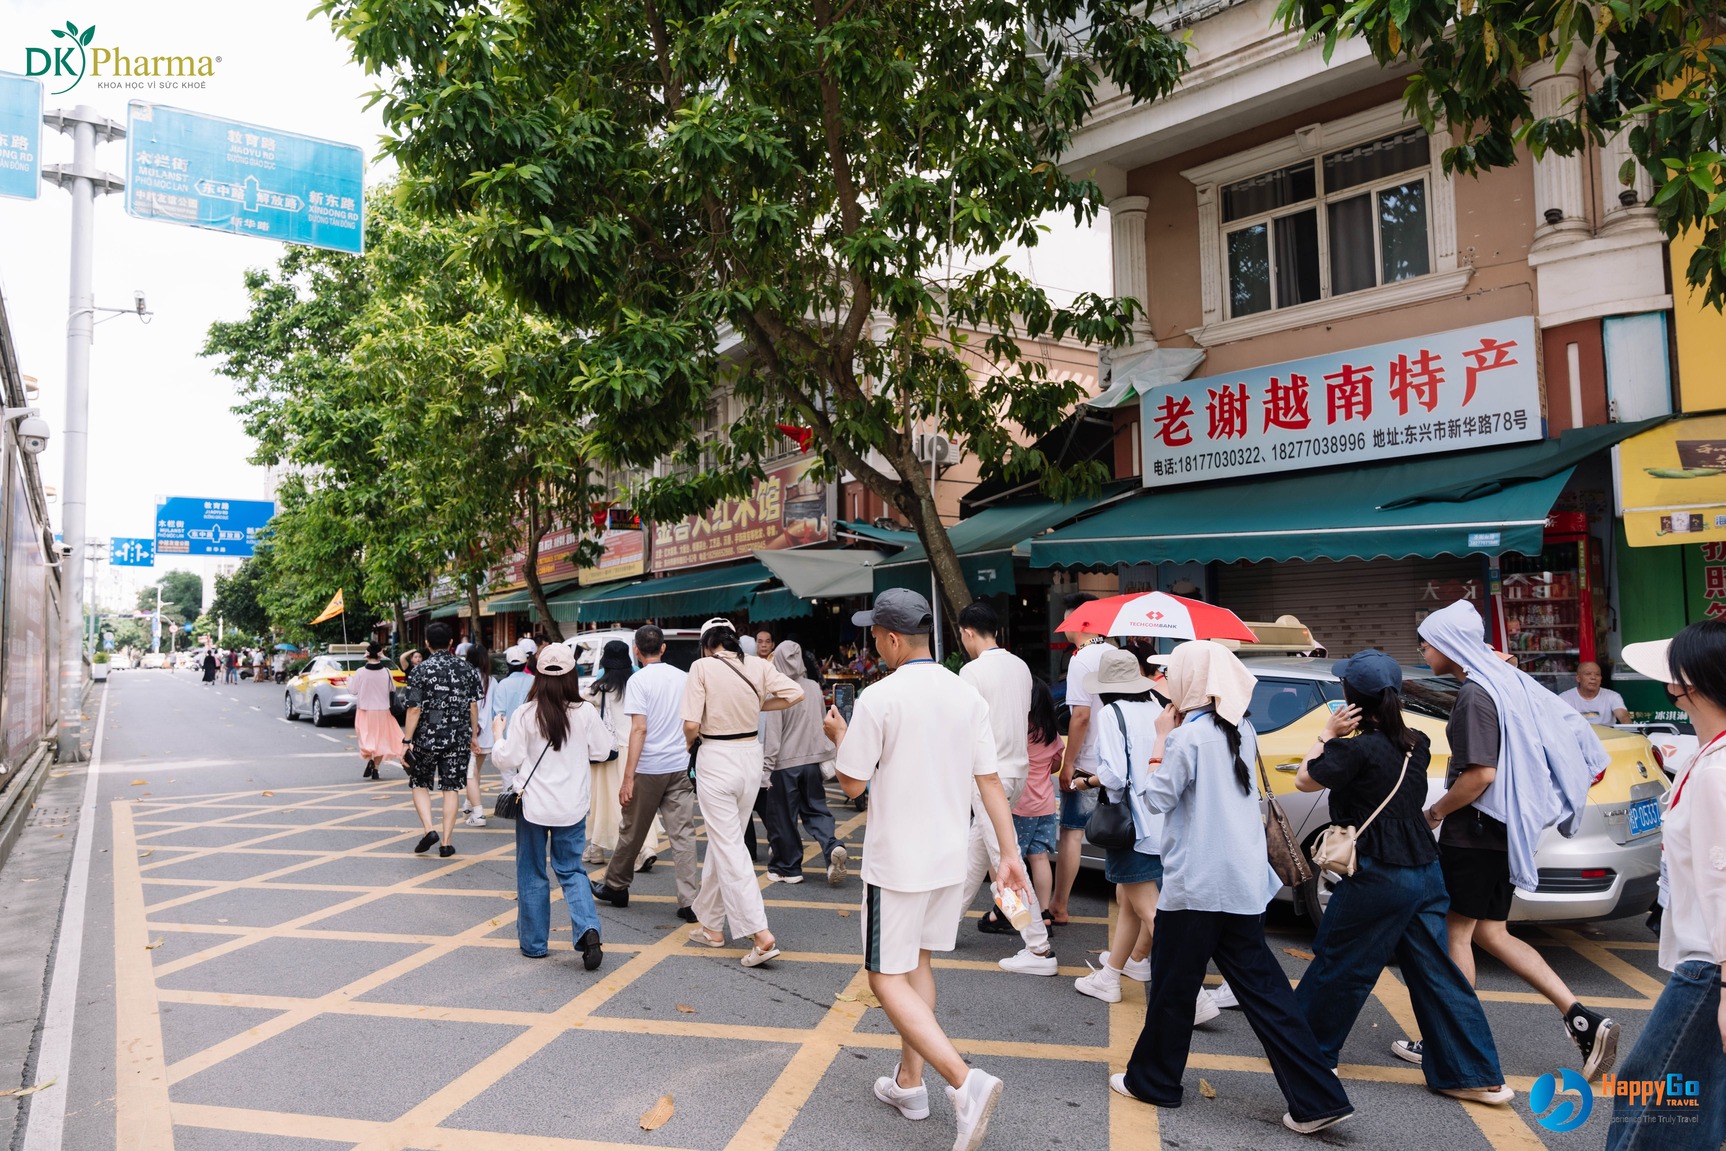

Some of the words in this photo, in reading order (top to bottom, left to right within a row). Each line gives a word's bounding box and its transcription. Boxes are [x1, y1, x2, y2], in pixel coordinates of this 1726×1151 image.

[227, 129, 276, 151] 教育路
[20, 151, 34, 162] RD
[136, 150, 189, 172] 木栏街
[229, 145, 260, 157] JIAOYU
[263, 151, 275, 160] RD
[172, 181, 188, 192] LAN
[202, 182, 245, 200] 东中路
[256, 190, 297, 210] 解放路
[309, 190, 355, 211] 新东路
[308, 205, 346, 219] XINDONG
[347, 212, 359, 221] RD
[230, 215, 270, 231] 新华路
[1152, 337, 1519, 448] 老谢越南特产
[1129, 621, 1178, 629] TECHCOMBANK
